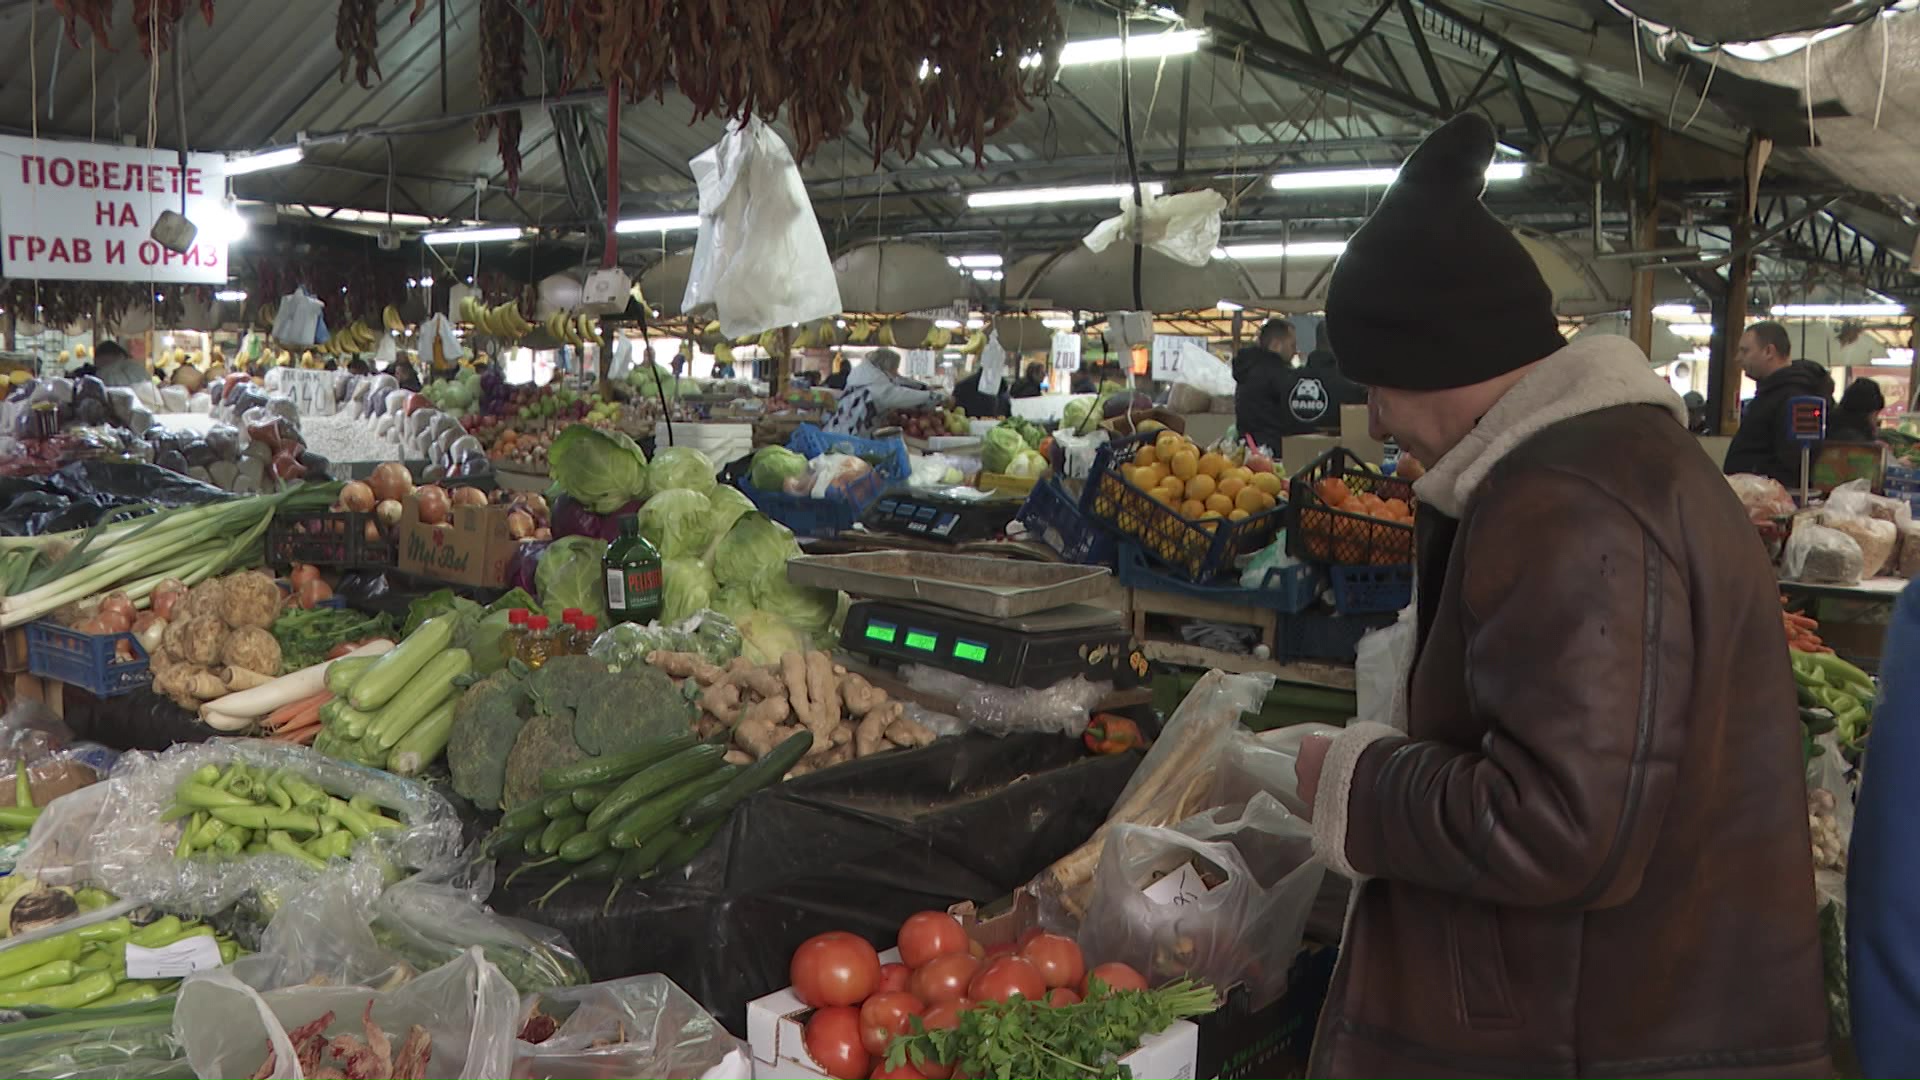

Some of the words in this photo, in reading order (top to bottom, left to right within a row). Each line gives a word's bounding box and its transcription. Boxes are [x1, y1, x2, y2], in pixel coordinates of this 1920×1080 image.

[21, 155, 203, 195] ПОВЕЛЕТЕ
[95, 201, 139, 227] НА
[8, 235, 92, 263] ГРАВ
[106, 239, 125, 264] И
[138, 239, 218, 266] ОРИЗ
